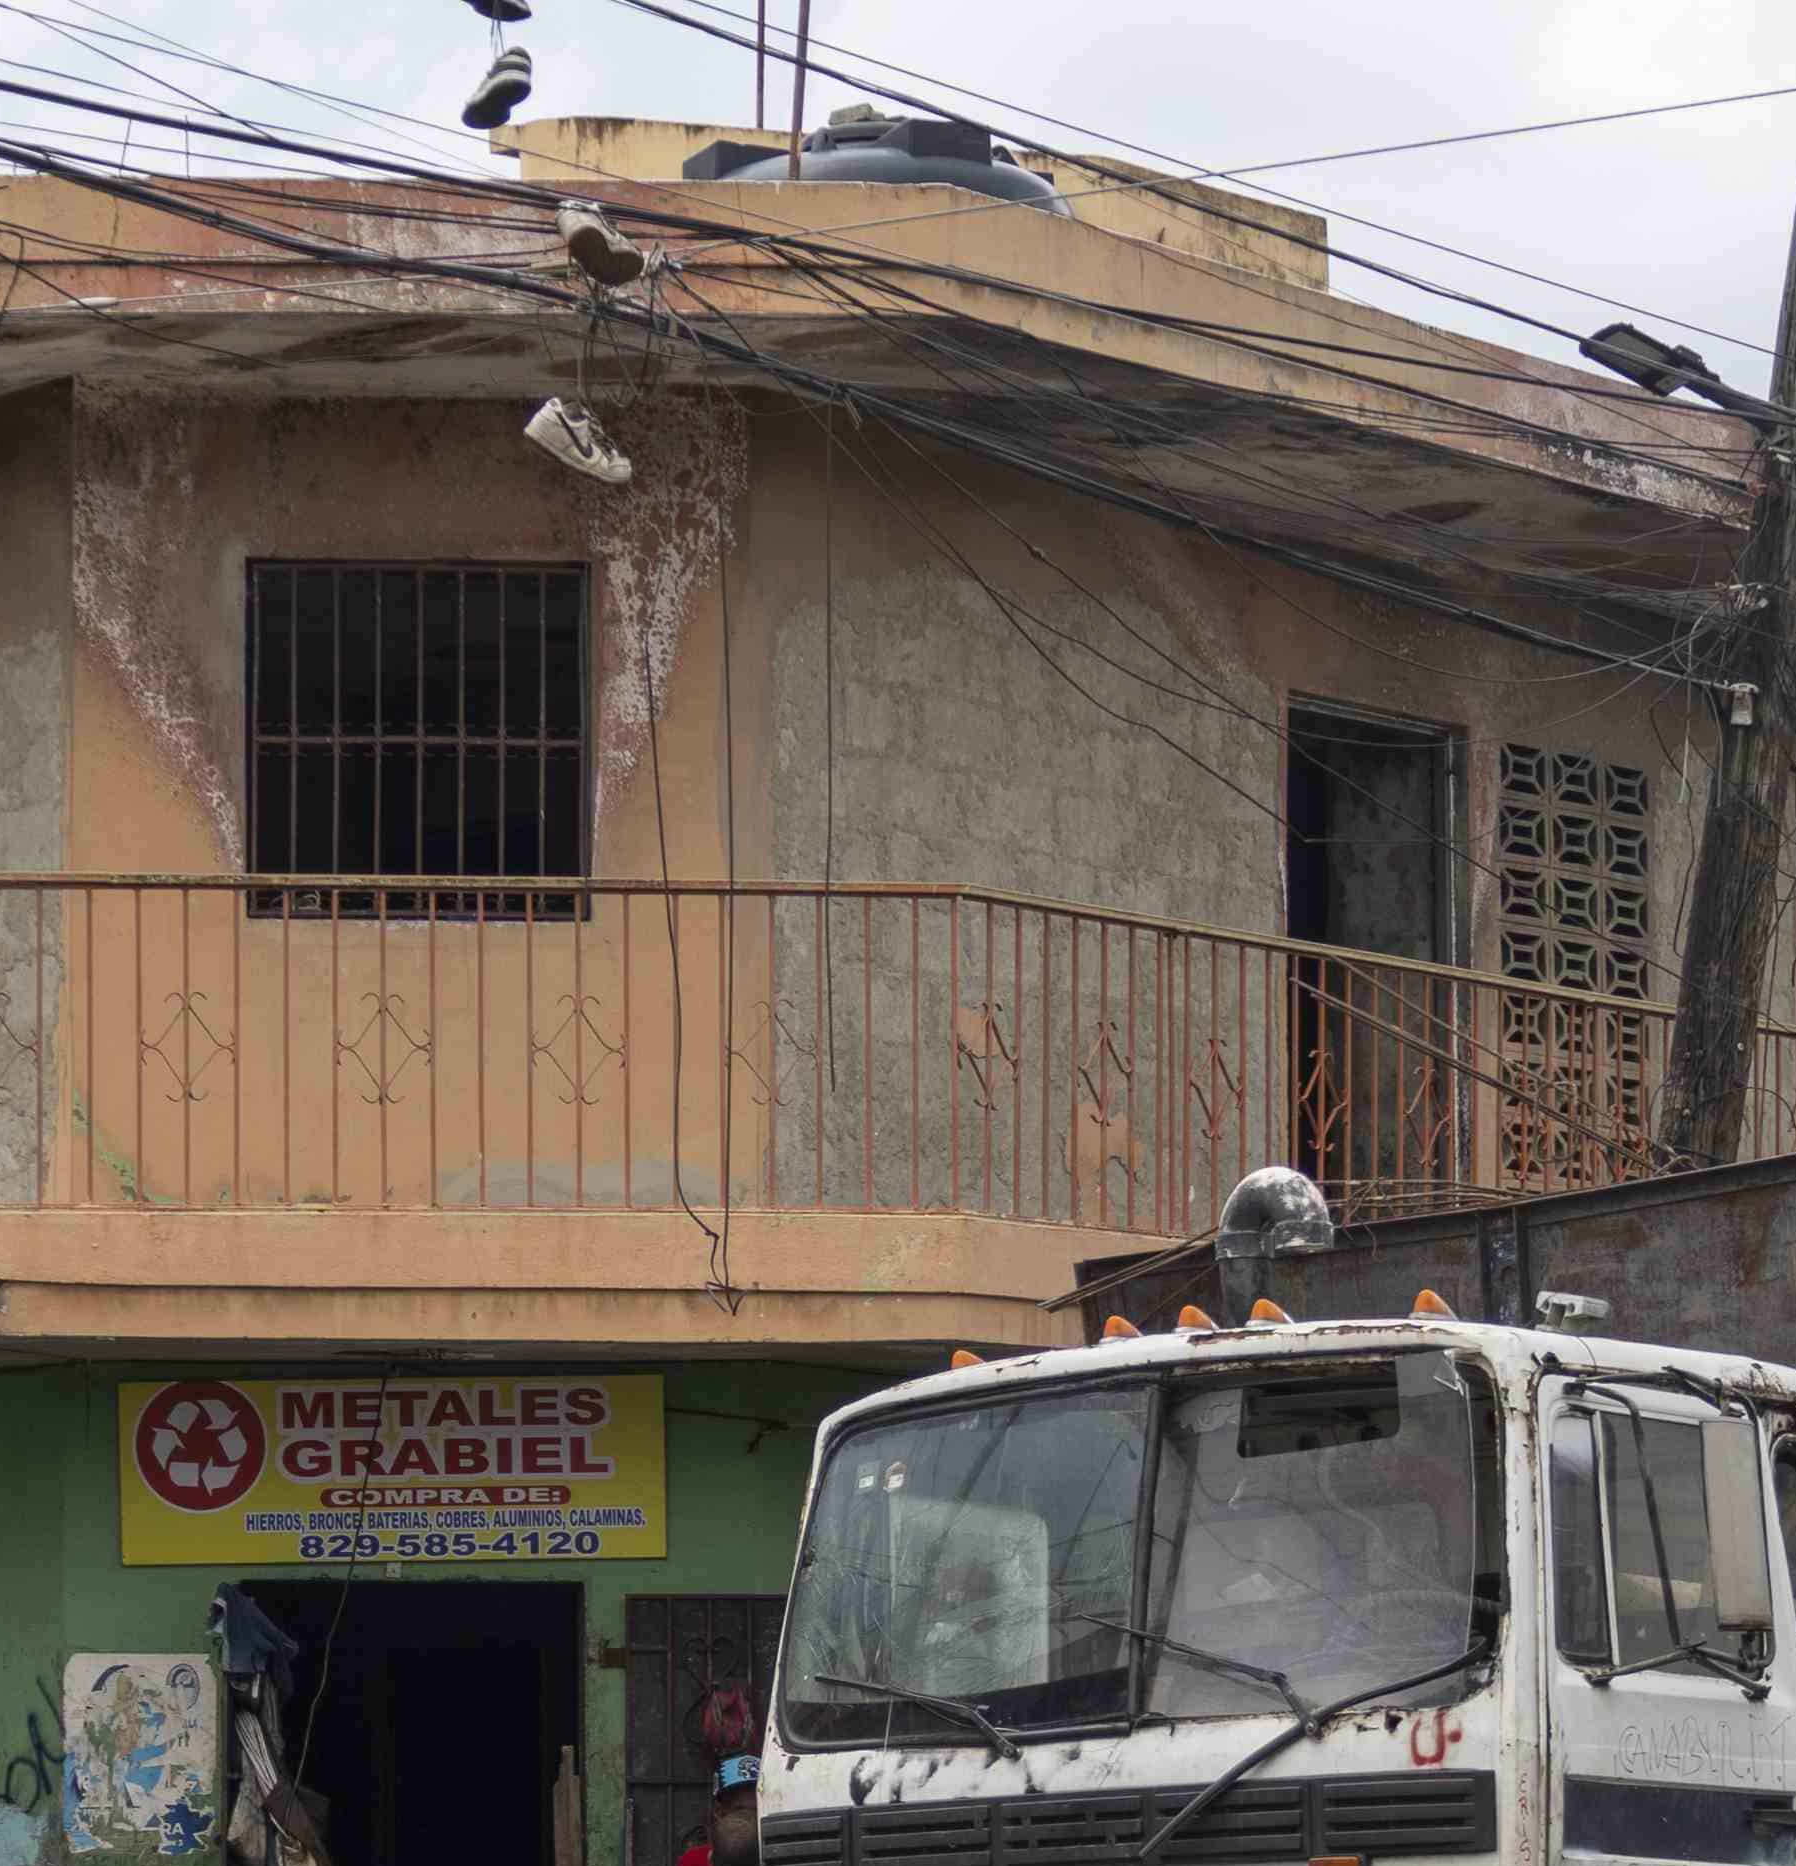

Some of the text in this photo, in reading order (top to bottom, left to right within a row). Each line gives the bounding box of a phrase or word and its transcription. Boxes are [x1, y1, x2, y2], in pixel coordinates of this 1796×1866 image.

[281, 1388, 607, 1429] METALES
[281, 1436, 610, 1478] GRABIEL
[330, 1487, 561, 1506] COMPRA DE:
[246, 1513, 305, 1533] HIERROS,
[368, 1511, 433, 1531] BATERIAS,
[435, 1510, 490, 1531] COBRES,
[492, 1508, 567, 1530] ALUMINIOS,
[299, 1531, 600, 1558] 829-585-4120
